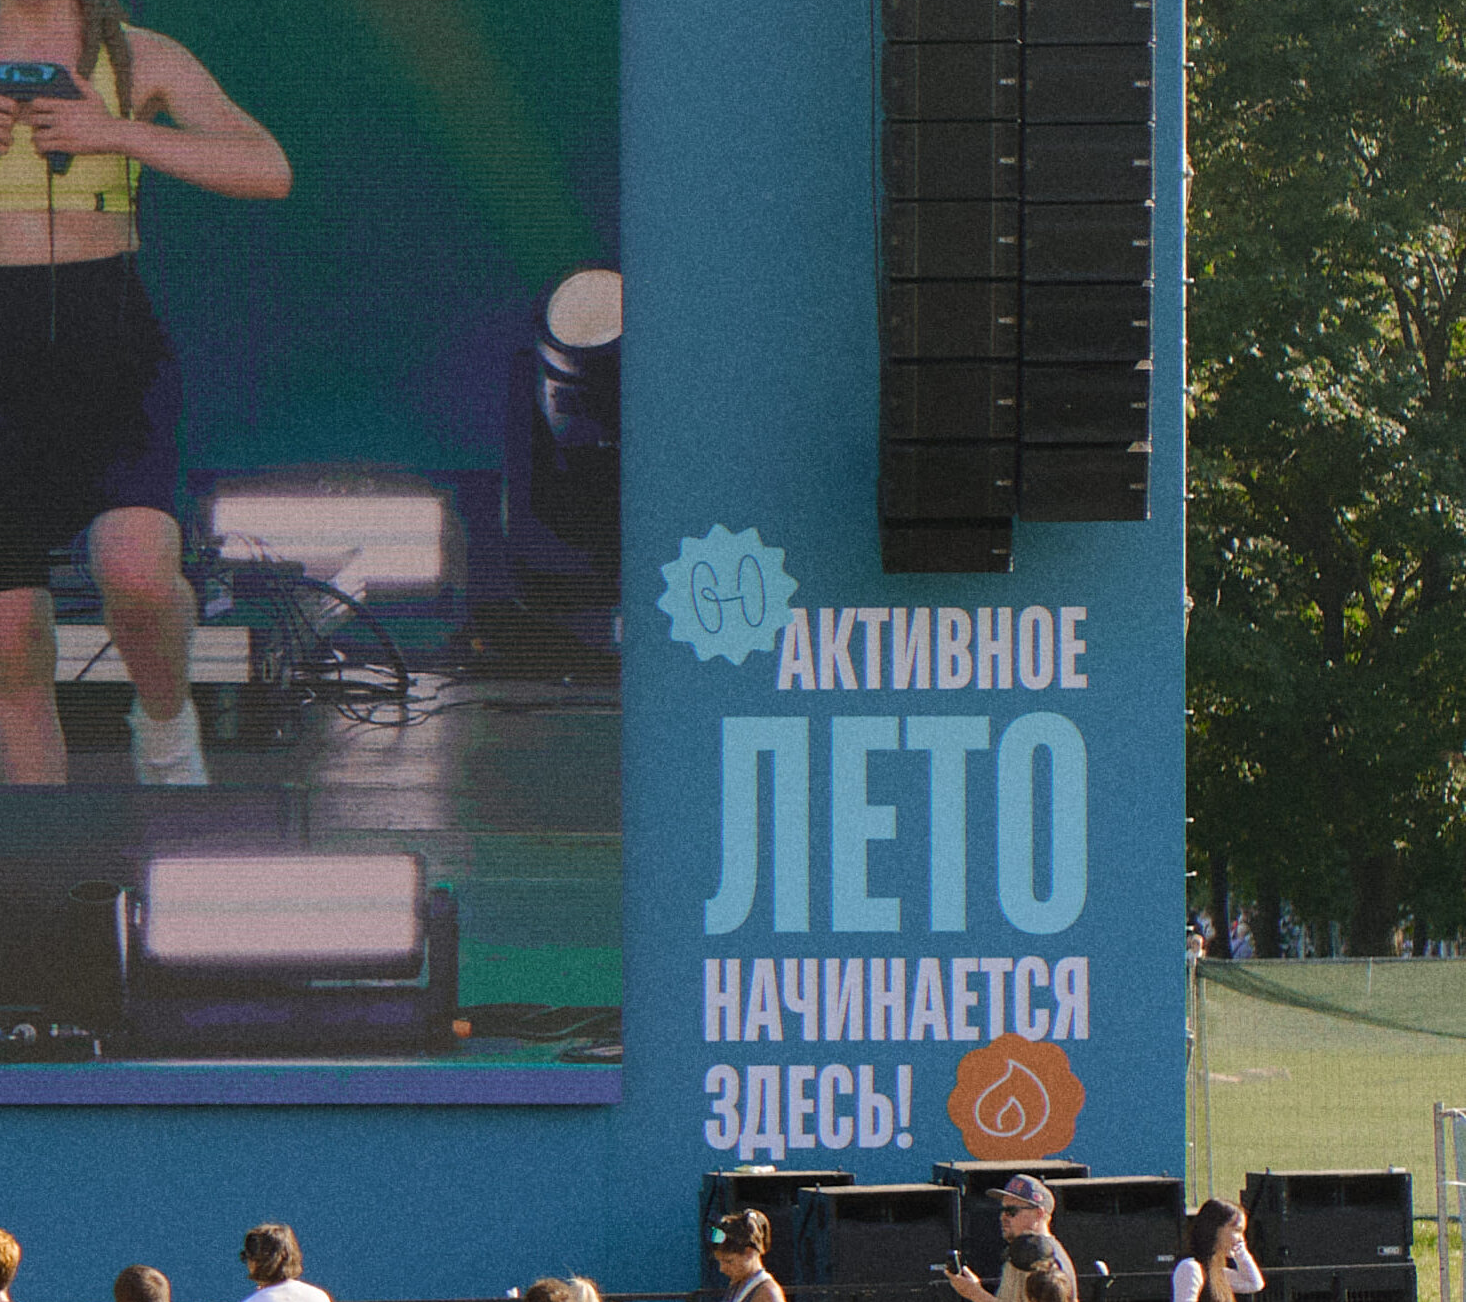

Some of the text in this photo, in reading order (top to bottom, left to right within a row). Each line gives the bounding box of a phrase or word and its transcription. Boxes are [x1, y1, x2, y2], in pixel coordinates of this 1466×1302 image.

[776, 605, 1089, 691] АКТИВНОЕ
[704, 710, 1088, 936] ЛЕТО
[704, 955, 1089, 1043] НАЧИНАЕТСЯ
[704, 1063, 914, 1161] ЗДЕСЬ!
